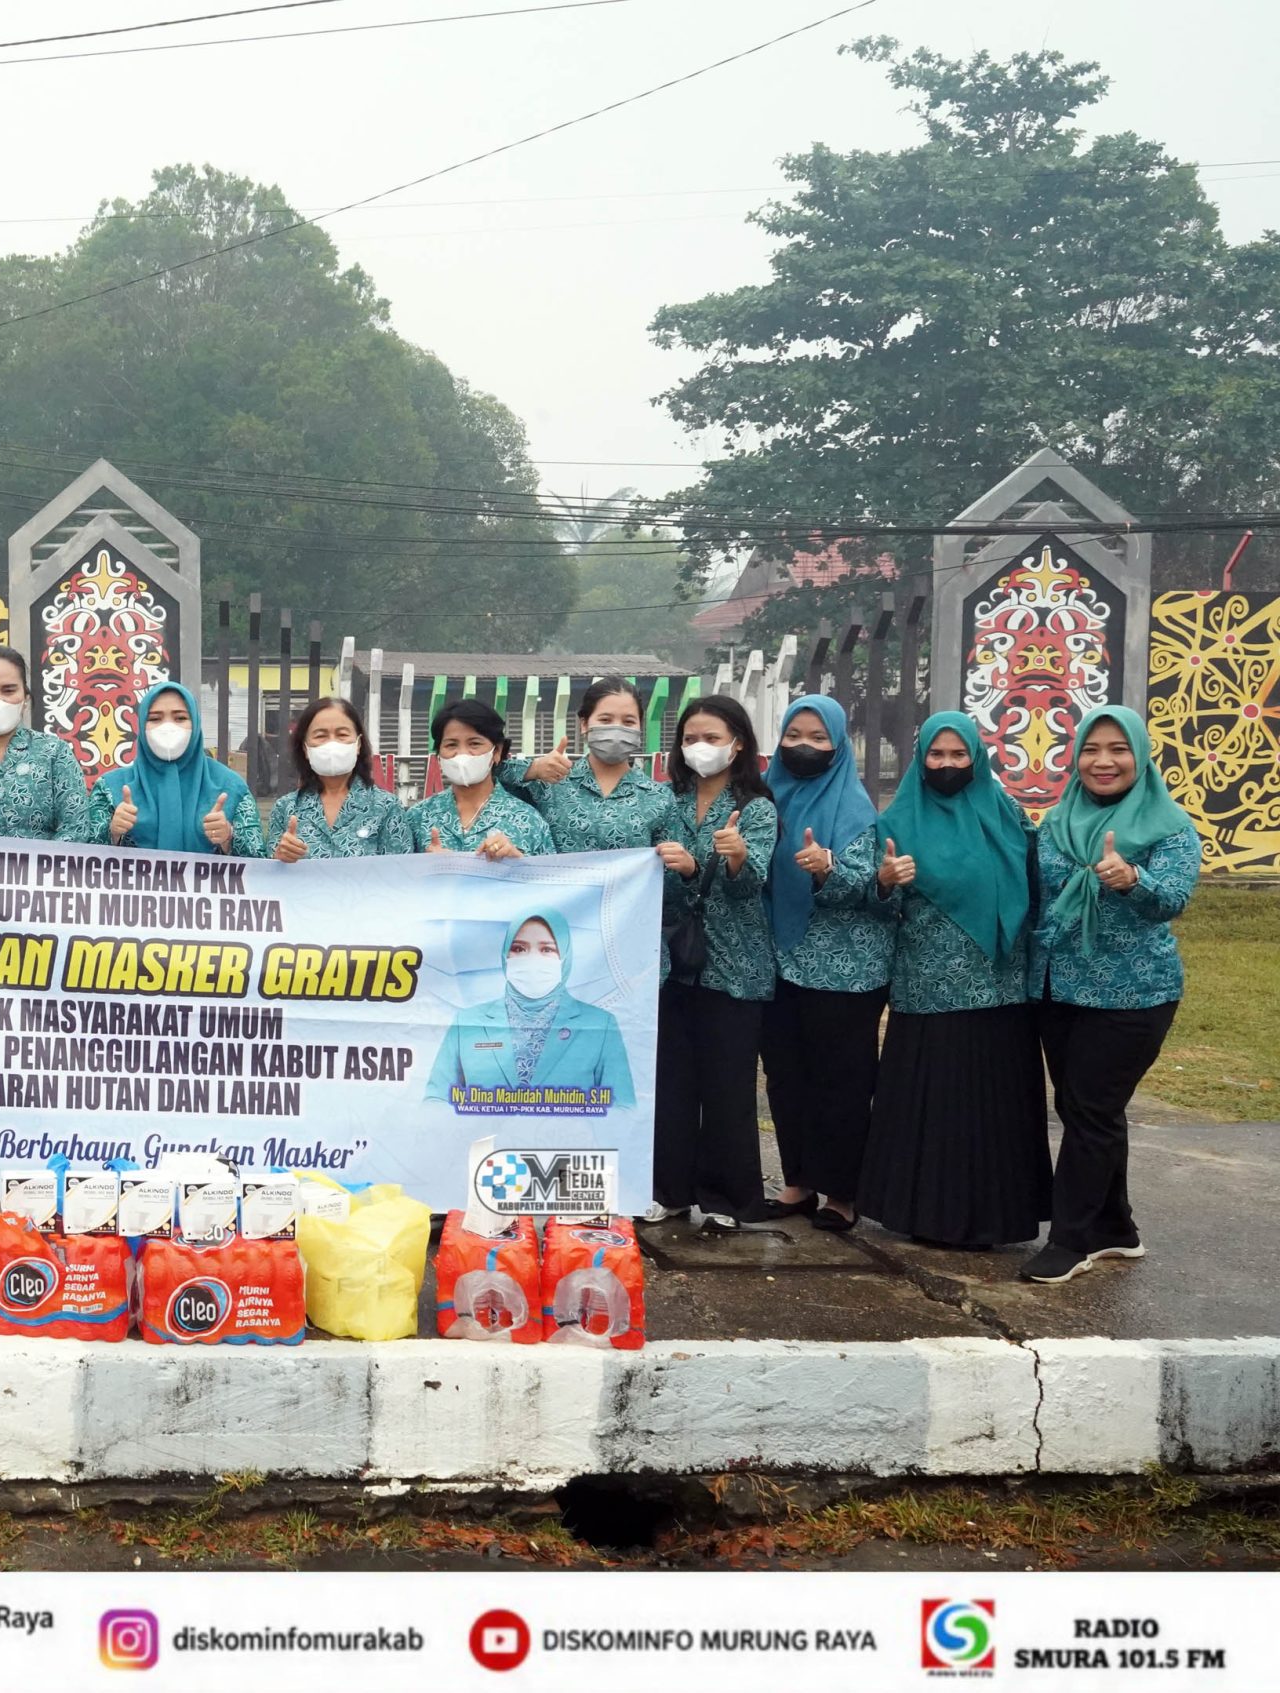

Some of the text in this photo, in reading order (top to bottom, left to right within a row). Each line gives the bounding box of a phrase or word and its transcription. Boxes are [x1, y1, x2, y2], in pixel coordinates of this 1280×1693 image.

[36, 854, 187, 893] PENGGERAK
[194, 861, 247, 895] PKK
[98, 892, 212, 931] MURUNG
[219, 898, 283, 933] RAYA
[63, 936, 251, 997] MASKER
[260, 945, 420, 1000] GRATIS
[19, 998, 194, 1037] MASYARAKAT
[199, 1005, 283, 1040] UMUM
[4, 1035, 244, 1076] PENANGGULANGAN
[250, 1044, 339, 1079] KABUT
[343, 1046, 413, 1081] ASAP
[66, 1075, 150, 1112] HUTAN
[157, 1078, 210, 1114] DAN
[217, 1080, 300, 1116] LAHAN
[452, 1087, 611, 1106] Ny. Dina Maulidah Muhidin, S.HI
[481, 1105, 504, 1113] KETUA
[65, 1264, 95, 1272] MURNI
[65, 1273, 99, 1281] AIRNYA
[10, 1273, 44, 1297] Cleo
[64, 1282, 95, 1291] SEGAR
[239, 1286, 269, 1295] MURNI
[63, 1292, 106, 1301] RASANYA
[238, 1297, 273, 1307] AIRNYA
[180, 1297, 217, 1322] Cleo
[237, 1309, 269, 1318] SEGAR
[236, 1318, 281, 1328] RASANYA
